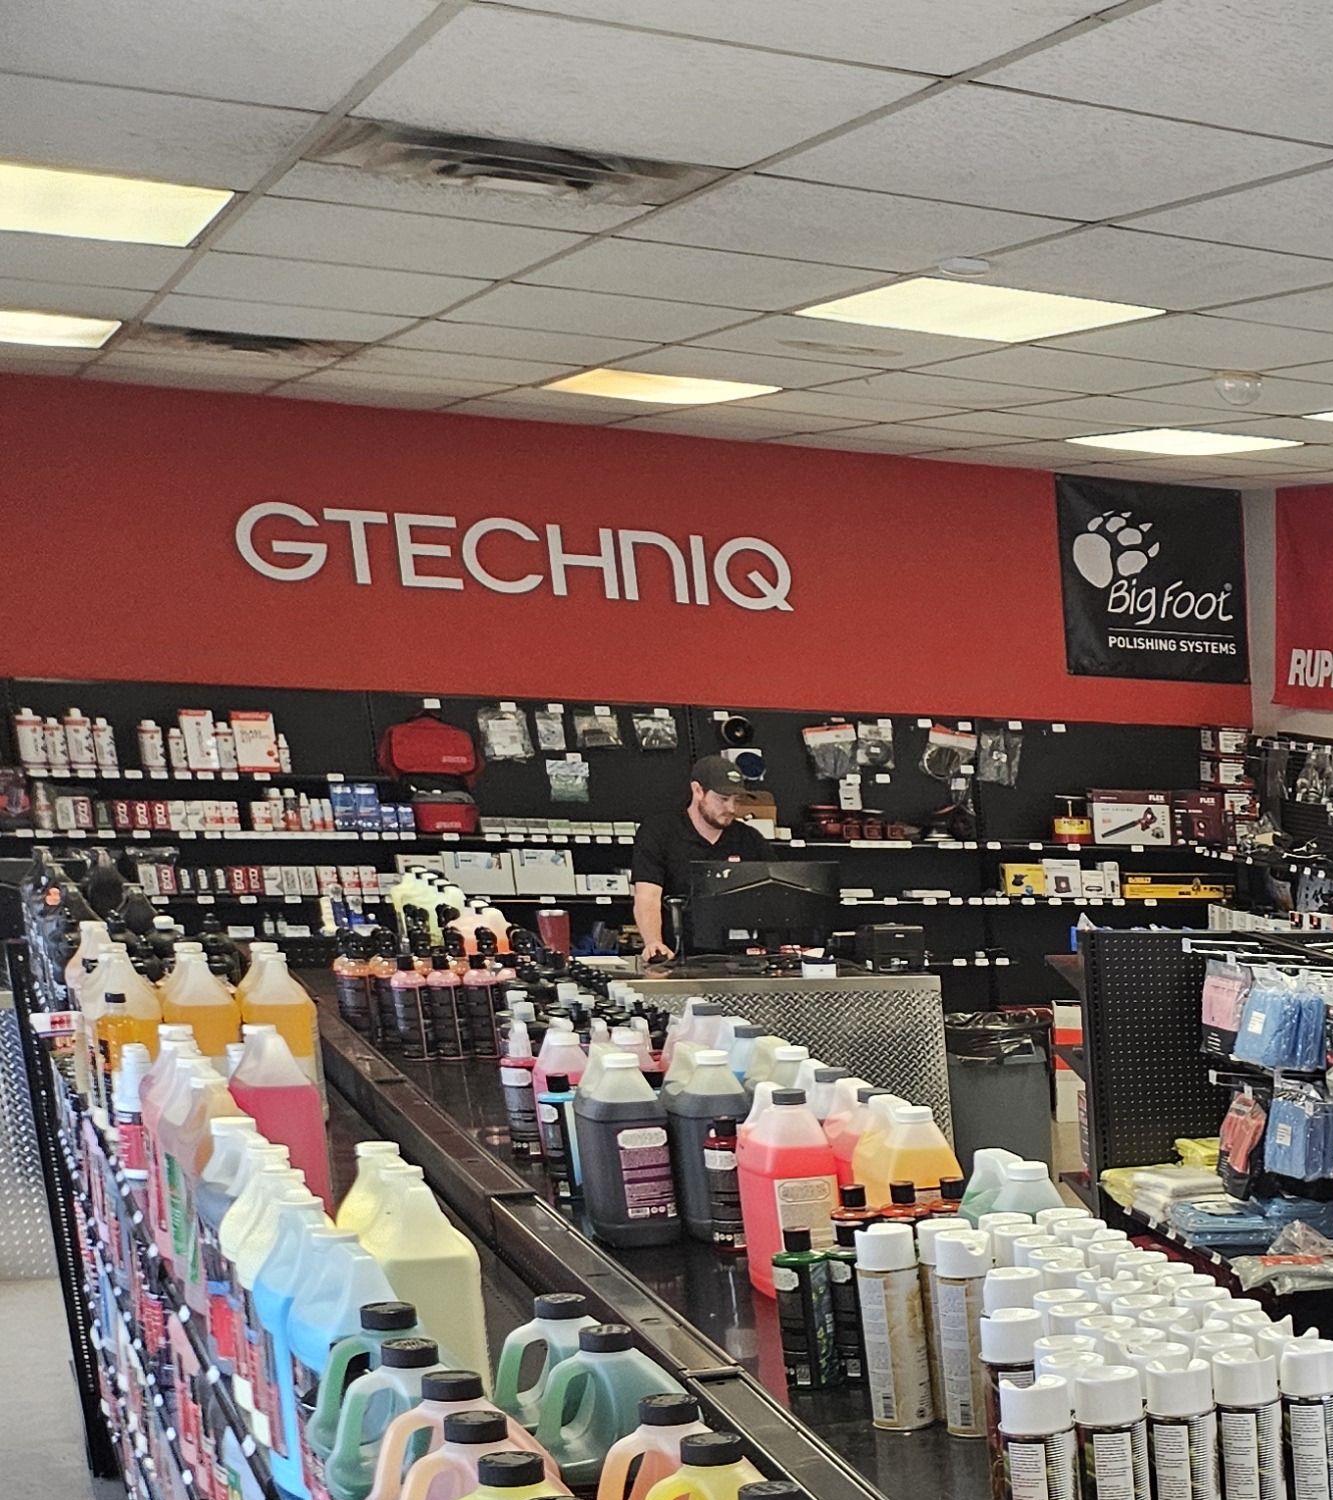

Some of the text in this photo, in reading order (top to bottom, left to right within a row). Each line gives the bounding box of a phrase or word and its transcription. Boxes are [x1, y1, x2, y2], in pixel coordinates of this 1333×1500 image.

[234, 500, 795, 613] GTECHNIQ
[1108, 635, 1237, 656] POLISHING SYSTEMS
